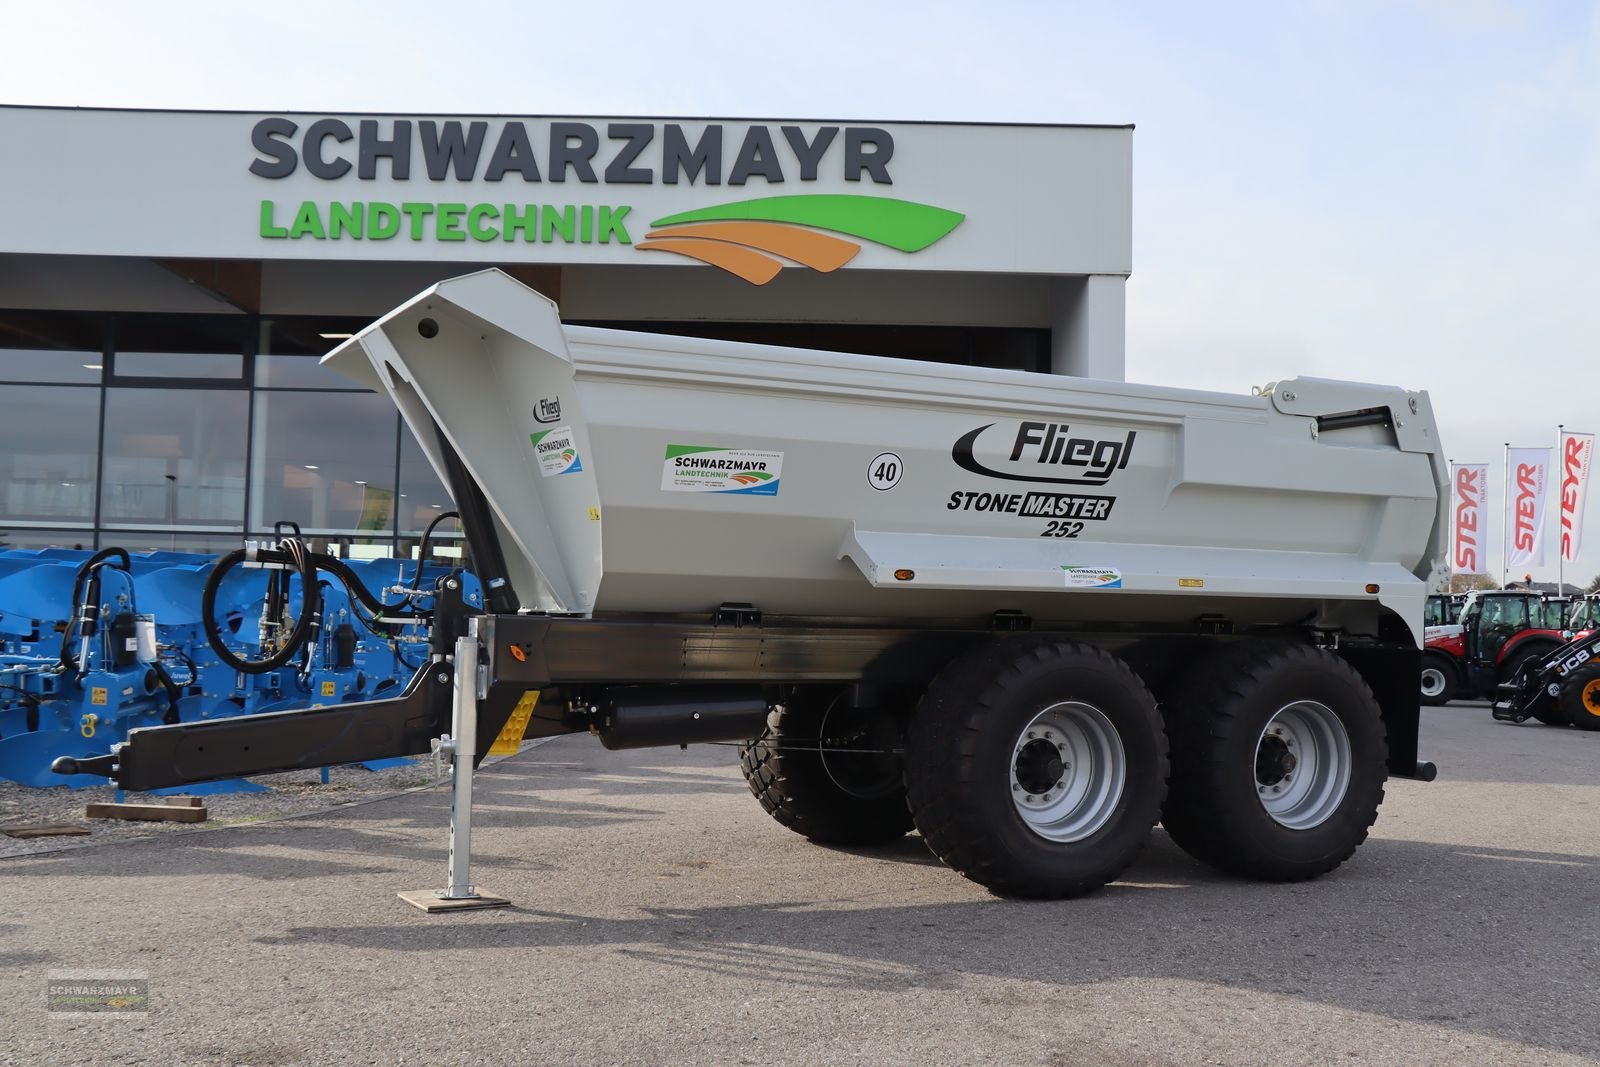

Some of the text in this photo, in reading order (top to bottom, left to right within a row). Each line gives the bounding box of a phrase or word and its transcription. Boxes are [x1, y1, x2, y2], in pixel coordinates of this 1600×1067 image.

[248, 117, 895, 186] SCHWARZMAYR
[259, 199, 633, 245] LANDTECHNIK
[1009, 421, 1137, 478] Fliegl
[675, 457, 767, 471] SCHWARZMAYR
[675, 470, 729, 479] LANDTECHNIK
[874, 462, 897, 482] 40
[947, 491, 1022, 513] STONE
[1515, 463, 1536, 552] STEYR
[1040, 520, 1084, 538] 252
[1455, 467, 1478, 572] STEYR
[1560, 650, 1590, 676] JCB
